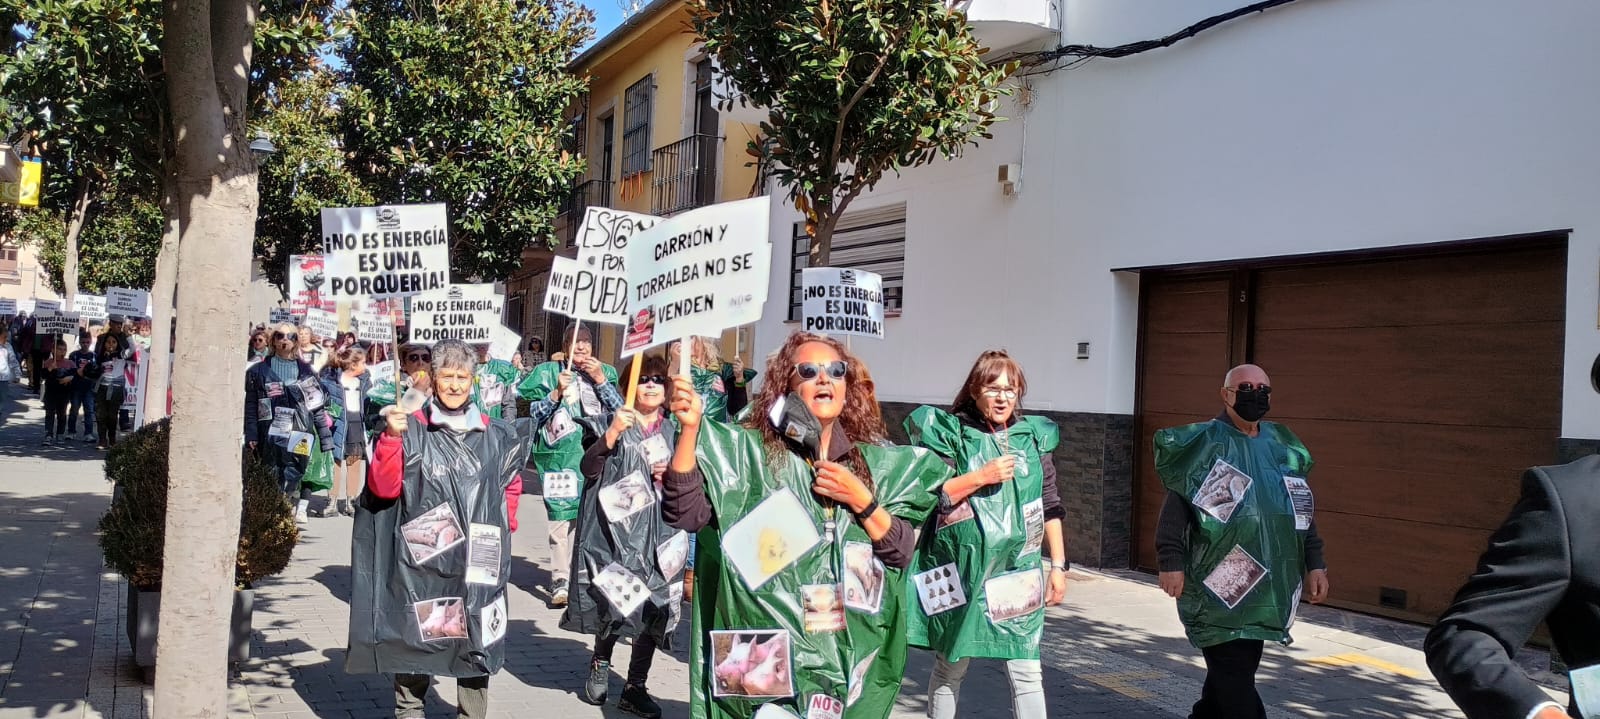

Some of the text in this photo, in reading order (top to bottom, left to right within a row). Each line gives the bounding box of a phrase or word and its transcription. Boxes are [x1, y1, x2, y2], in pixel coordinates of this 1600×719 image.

[325, 225, 446, 254] ¡NO ES ENERGÍA
[654, 224, 728, 262] CARRIÓN Y
[358, 250, 423, 273] ES UNA
[602, 254, 625, 272] POR
[331, 267, 444, 296] PORQUERÍA!
[550, 272, 563, 288] NI
[636, 252, 753, 302] TORRALBA NO SE
[549, 293, 561, 309] NI
[804, 285, 826, 301] ¡NO
[829, 285, 842, 298] ES
[413, 301, 434, 313] ¡NO
[436, 301, 448, 312] ES
[659, 293, 714, 323] VENDEN
[825, 300, 869, 317] ES UNA
[432, 313, 475, 326] ES UNA
[806, 315, 882, 336] PORQUERÍA!
[813, 696, 832, 711] NO
